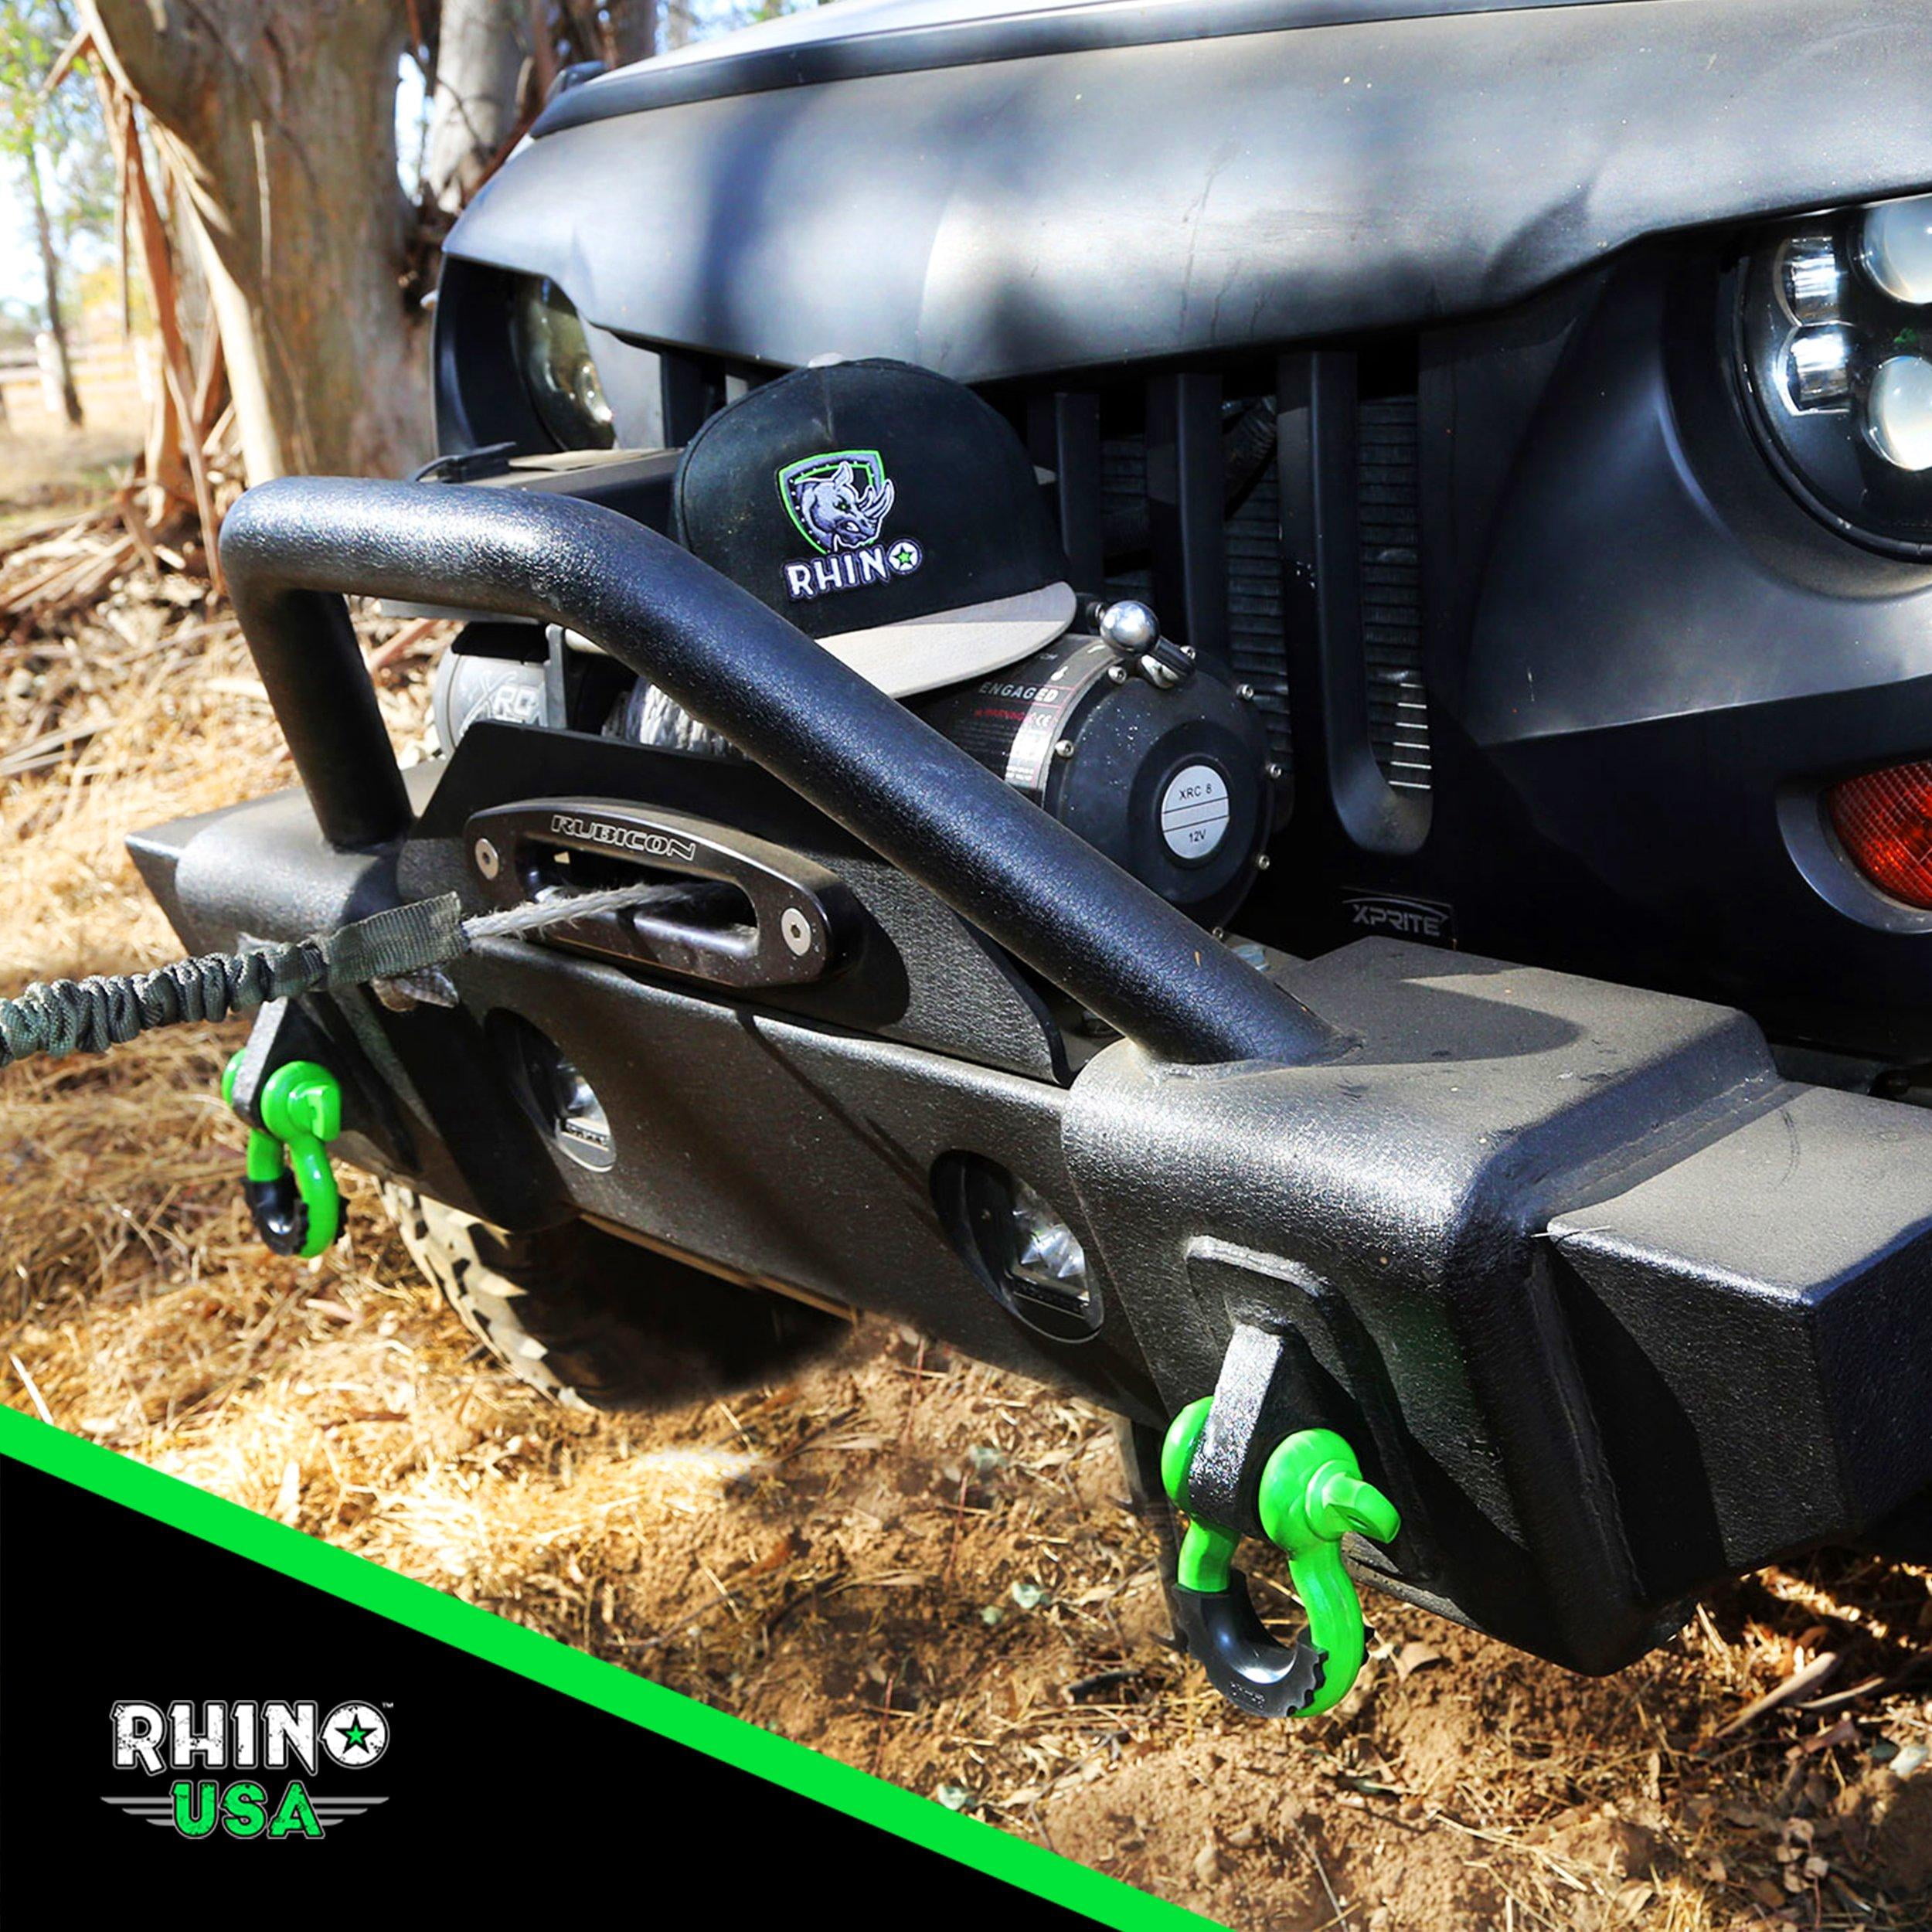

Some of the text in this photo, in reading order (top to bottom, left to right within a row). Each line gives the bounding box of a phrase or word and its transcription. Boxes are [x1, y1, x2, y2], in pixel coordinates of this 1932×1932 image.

[784, 539, 921, 600] RHINO
[978, 682, 1059, 703] ENGAGED
[1179, 785, 1202, 801] XRC
[550, 815, 696, 861] RUBICON
[1189, 829, 1206, 843] 12V
[1352, 903, 1440, 936] XPRITE
